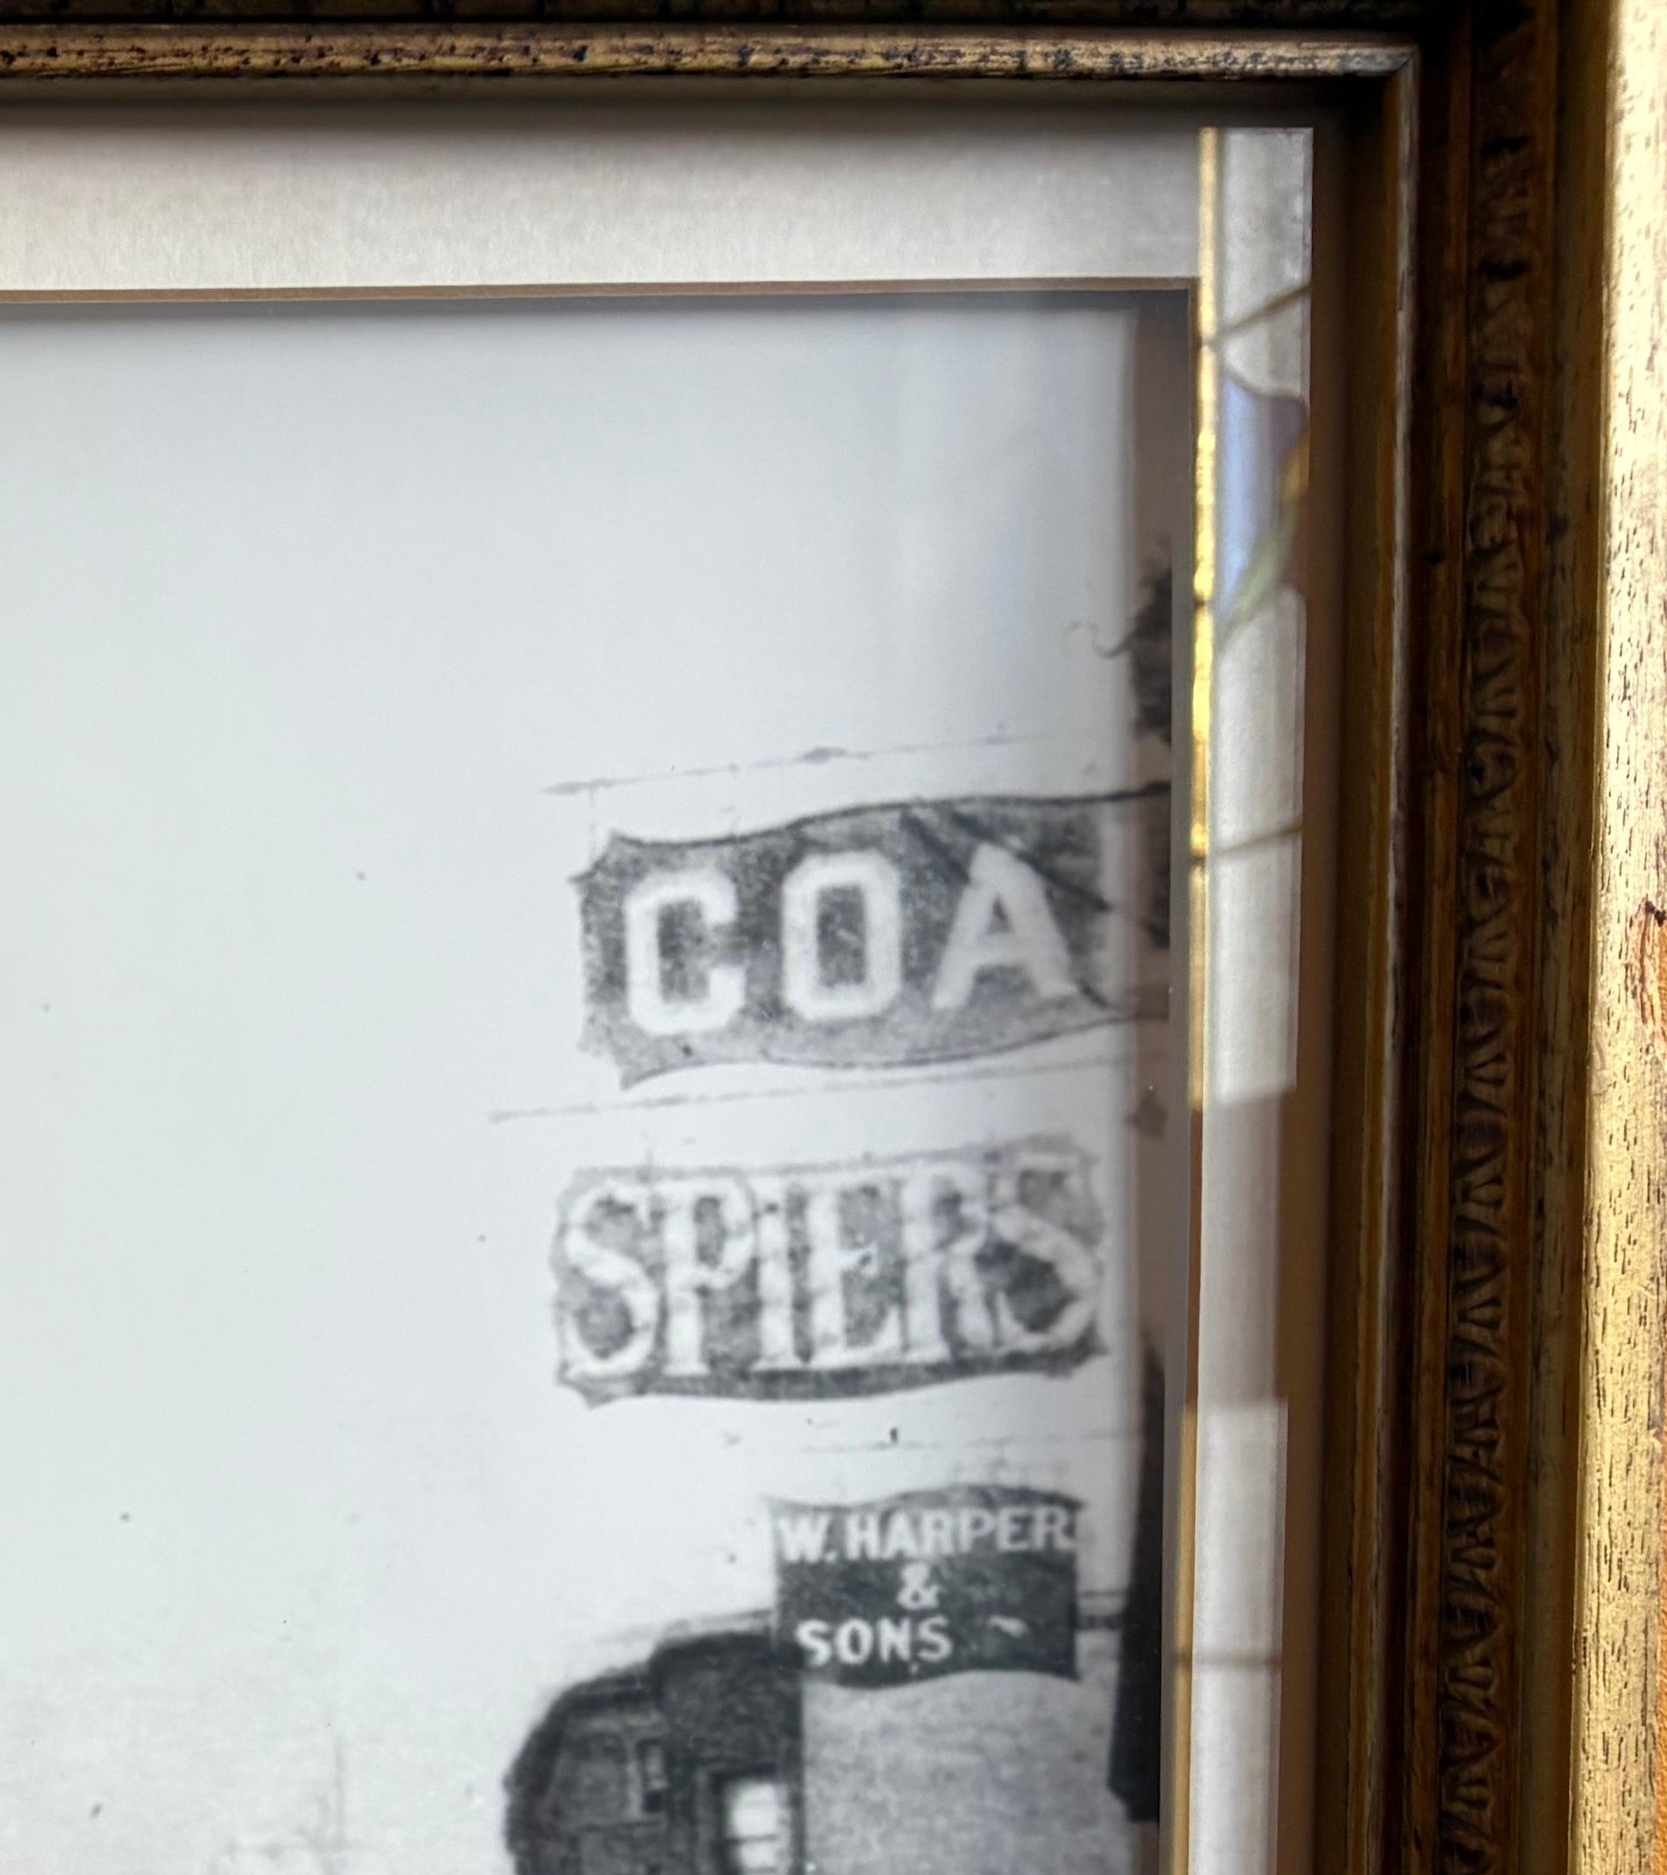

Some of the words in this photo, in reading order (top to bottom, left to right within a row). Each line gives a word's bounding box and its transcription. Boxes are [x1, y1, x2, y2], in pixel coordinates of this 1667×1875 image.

[565, 1155, 1101, 1377] SPIERS
[896, 1561, 940, 1611] &
[795, 1615, 953, 1668] SONS
